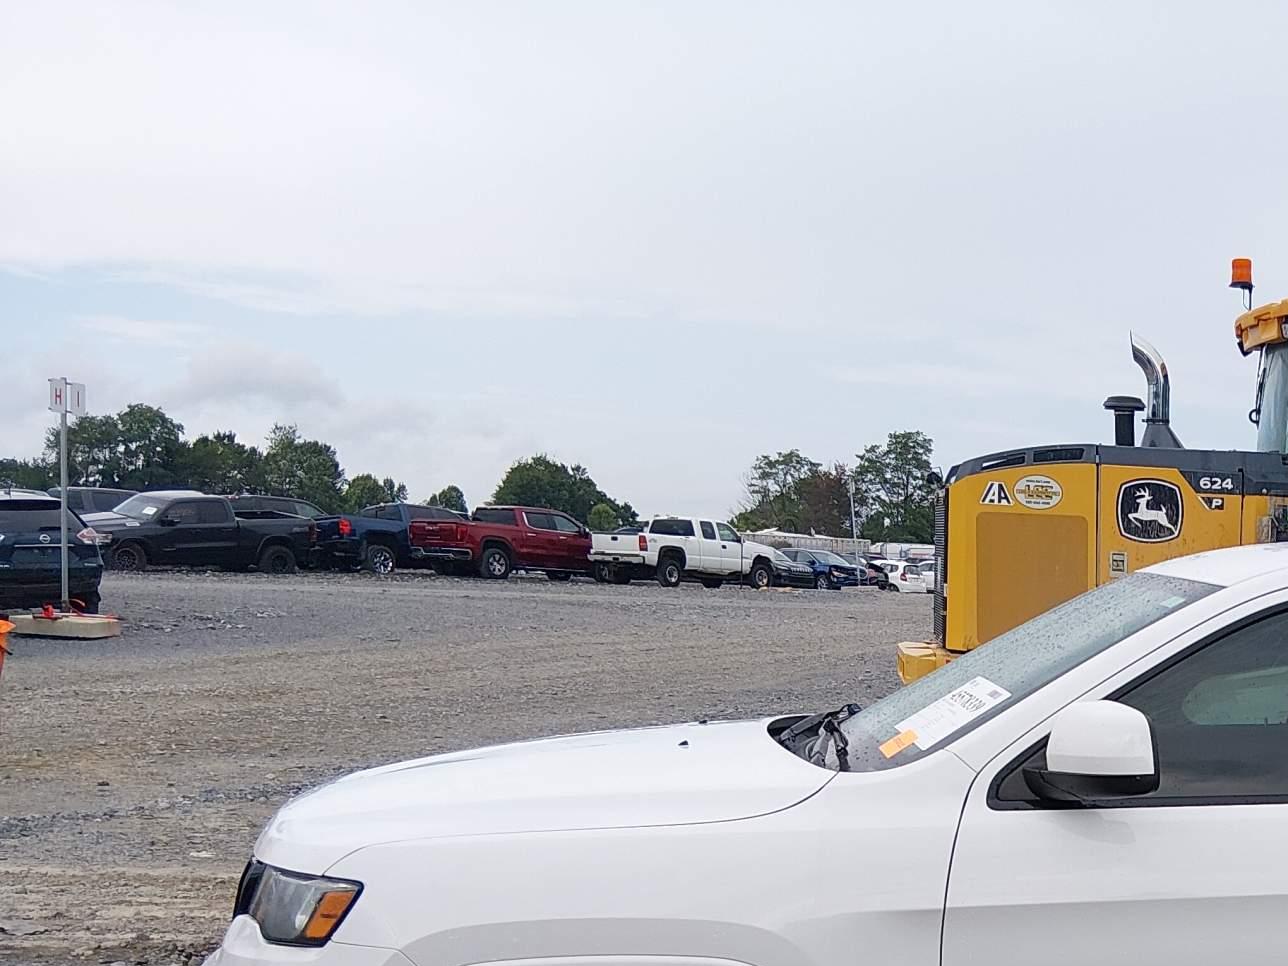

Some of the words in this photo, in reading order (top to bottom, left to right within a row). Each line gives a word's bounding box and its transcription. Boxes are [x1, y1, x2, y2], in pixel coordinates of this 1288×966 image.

[54, 387, 62, 406] H
[1199, 476, 1234, 490] 624
[1211, 498, 1223, 509] P
